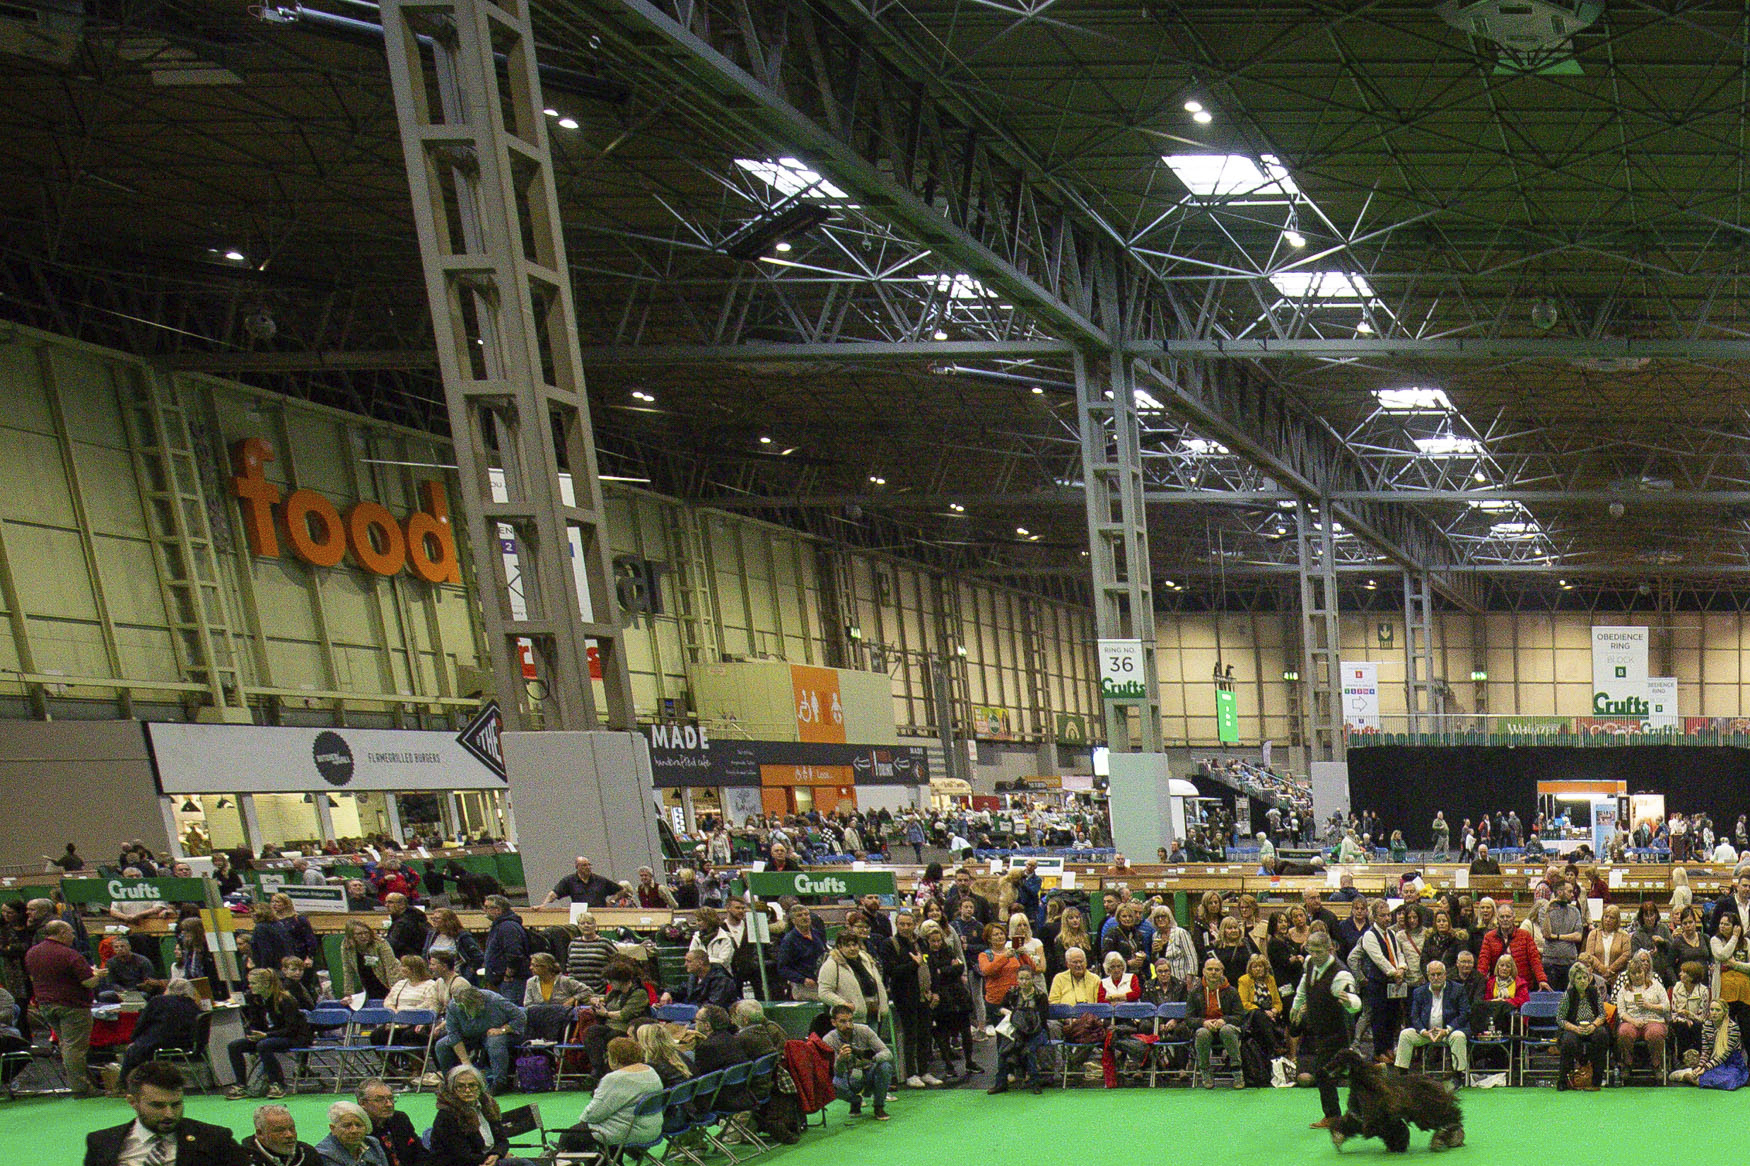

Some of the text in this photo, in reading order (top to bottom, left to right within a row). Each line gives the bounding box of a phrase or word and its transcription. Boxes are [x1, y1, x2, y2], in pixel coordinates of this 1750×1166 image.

[231, 437, 462, 584] food
[1110, 656, 1134, 672] 36
[1101, 677, 1146, 694] Crufts
[1593, 692, 1649, 713] Crufts
[651, 724, 710, 750] MADE
[107, 880, 161, 899] Crufts
[794, 874, 847, 893] Crufts
